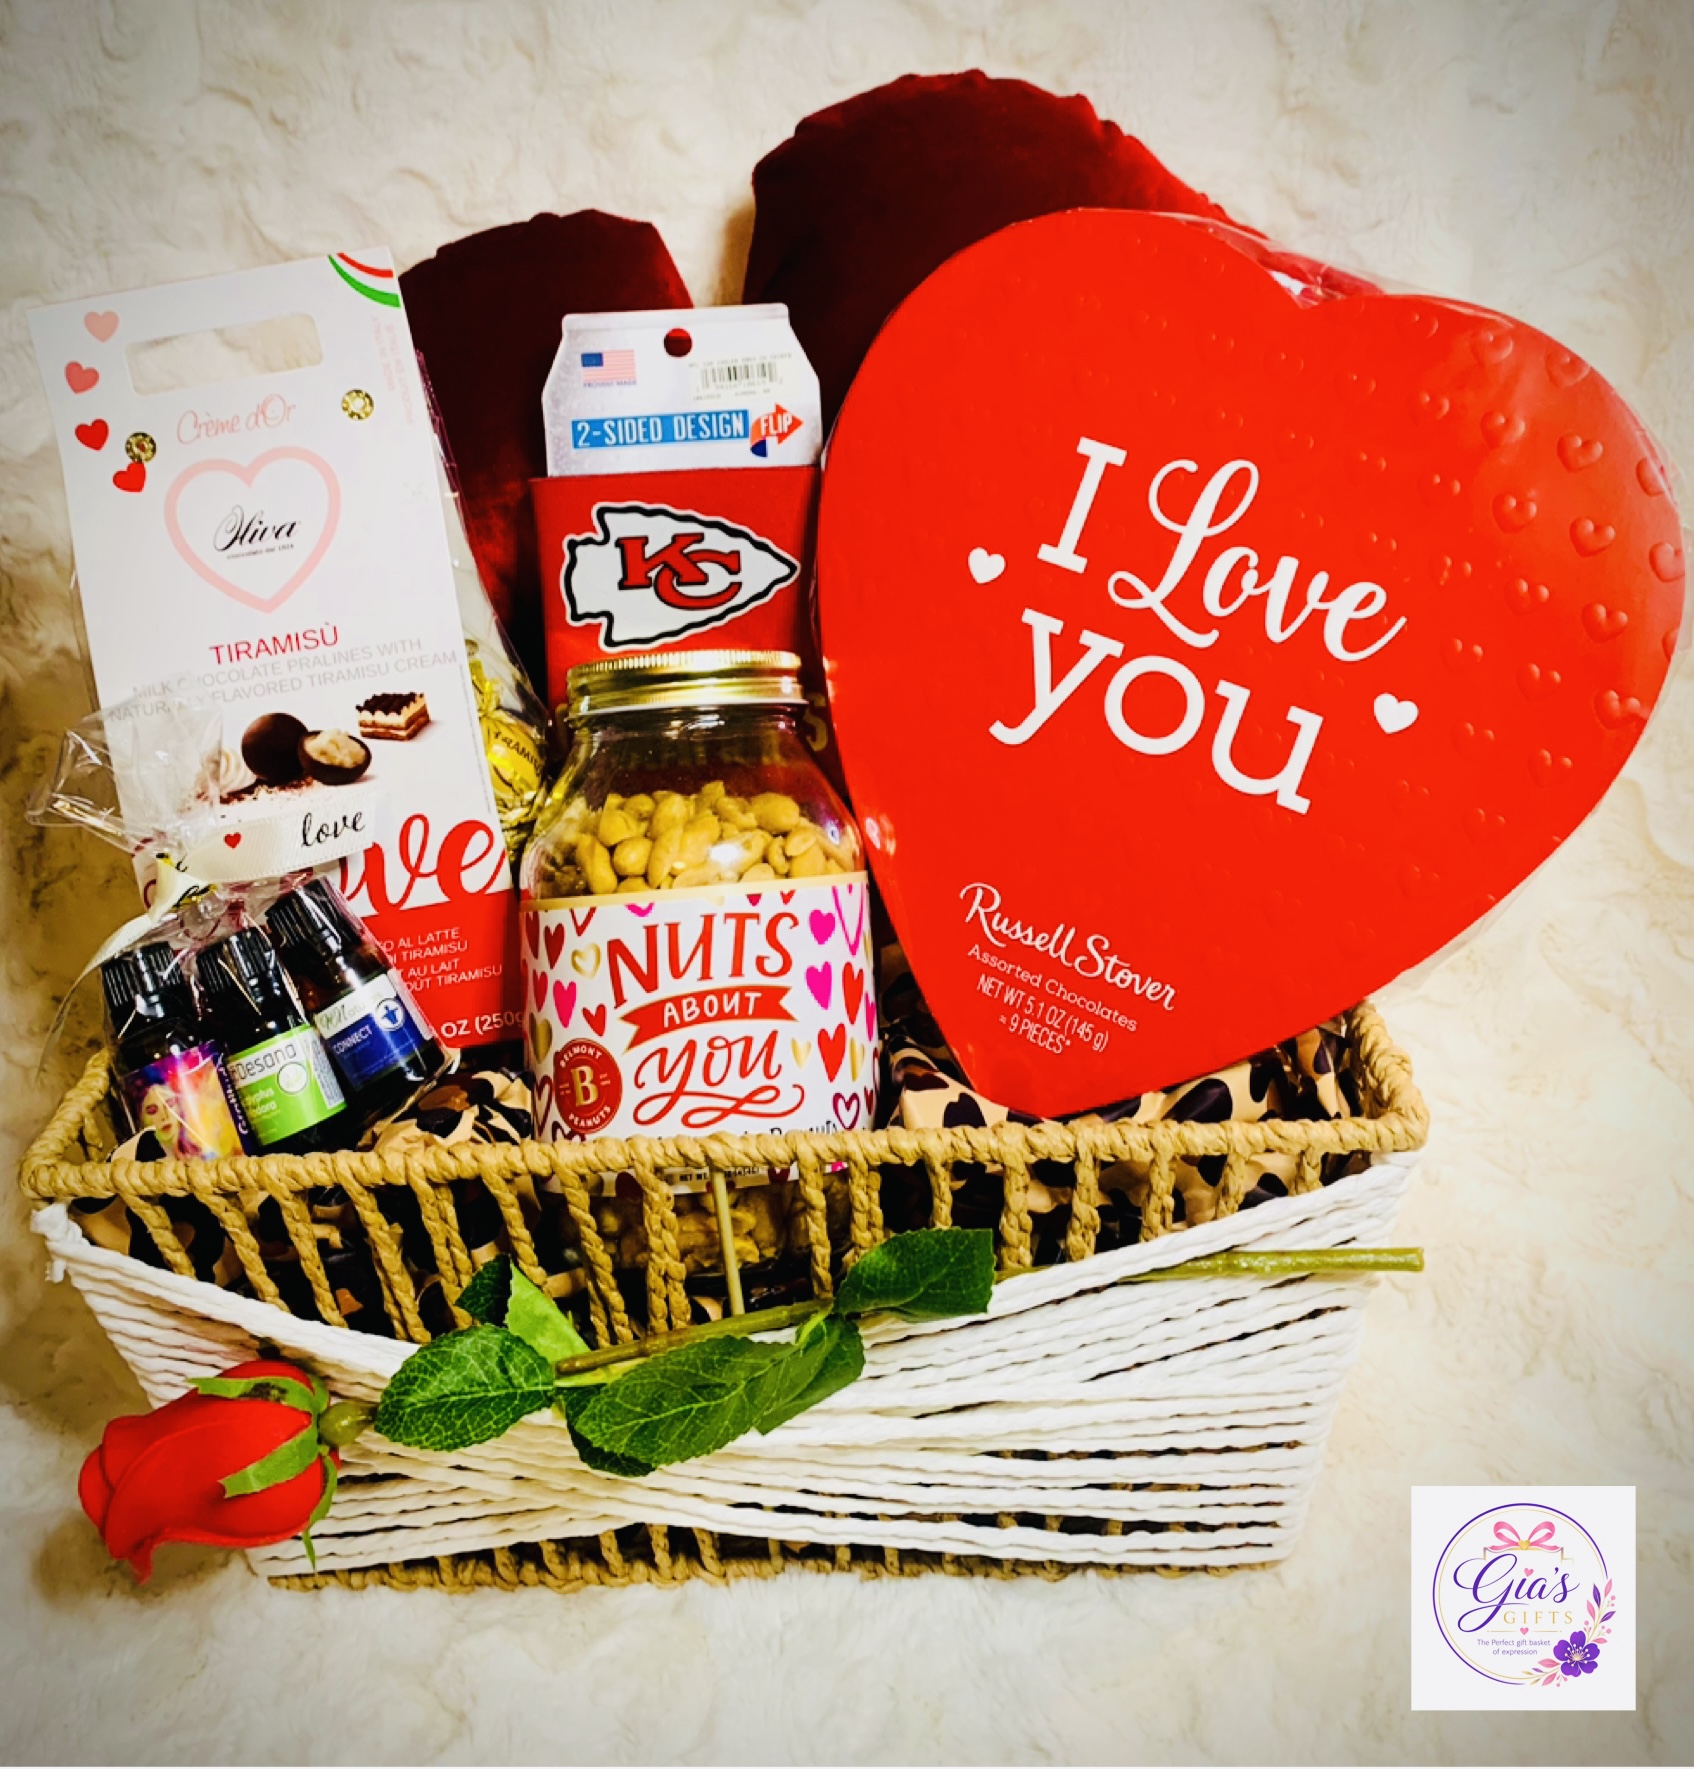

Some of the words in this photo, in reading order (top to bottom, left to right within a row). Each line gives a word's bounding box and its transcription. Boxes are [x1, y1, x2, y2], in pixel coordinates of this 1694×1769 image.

[177, 409, 241, 445] Crème
[576, 416, 663, 447] 2-SIDED
[673, 411, 744, 442] DESIGN
[760, 413, 794, 437] FLIP
[1036, 436, 1128, 574] I
[1107, 459, 1407, 662] Love
[614, 532, 743, 611] KC
[208, 621, 340, 666] TIRAMISÙ
[177, 660, 283, 692] COCOLATE
[286, 646, 373, 673] PRALINES
[376, 638, 422, 658] WITH
[212, 677, 303, 704] FLAVORED
[308, 661, 390, 688] TIRAMISU
[394, 650, 458, 674] CREAM
[988, 608, 1324, 816] you
[301, 812, 366, 848] love
[398, 936, 414, 949] AL
[417, 927, 461, 946] LATTE
[401, 940, 468, 963] TIRAMISU
[959, 881, 1076, 967] Russell
[1073, 933, 1177, 1011] Stover
[408, 965, 429, 978] AU
[430, 957, 461, 975] LAIT
[437, 964, 503, 987] TIRAMISU
[606, 911, 800, 1009] NUTS
[967, 943, 1043, 988] Assorted
[1045, 978, 1138, 1032] Chocolates
[662, 991, 763, 1028] ABOUT
[976, 973, 1004, 999] NET
[1003, 984, 1026, 1008] WT
[1024, 995, 1046, 1017] 5.1
[1045, 1004, 1068, 1028] OZ
[1064, 1014, 1095, 1042] (145
[1008, 1013, 1020, 1034] 9
[440, 1019, 471, 1039] OZ
[559, 1045, 603, 1068] BELMONT
[570, 1065, 599, 1107] B
[632, 1030, 805, 1129] you
[568, 1105, 611, 1128] PEANUTS
